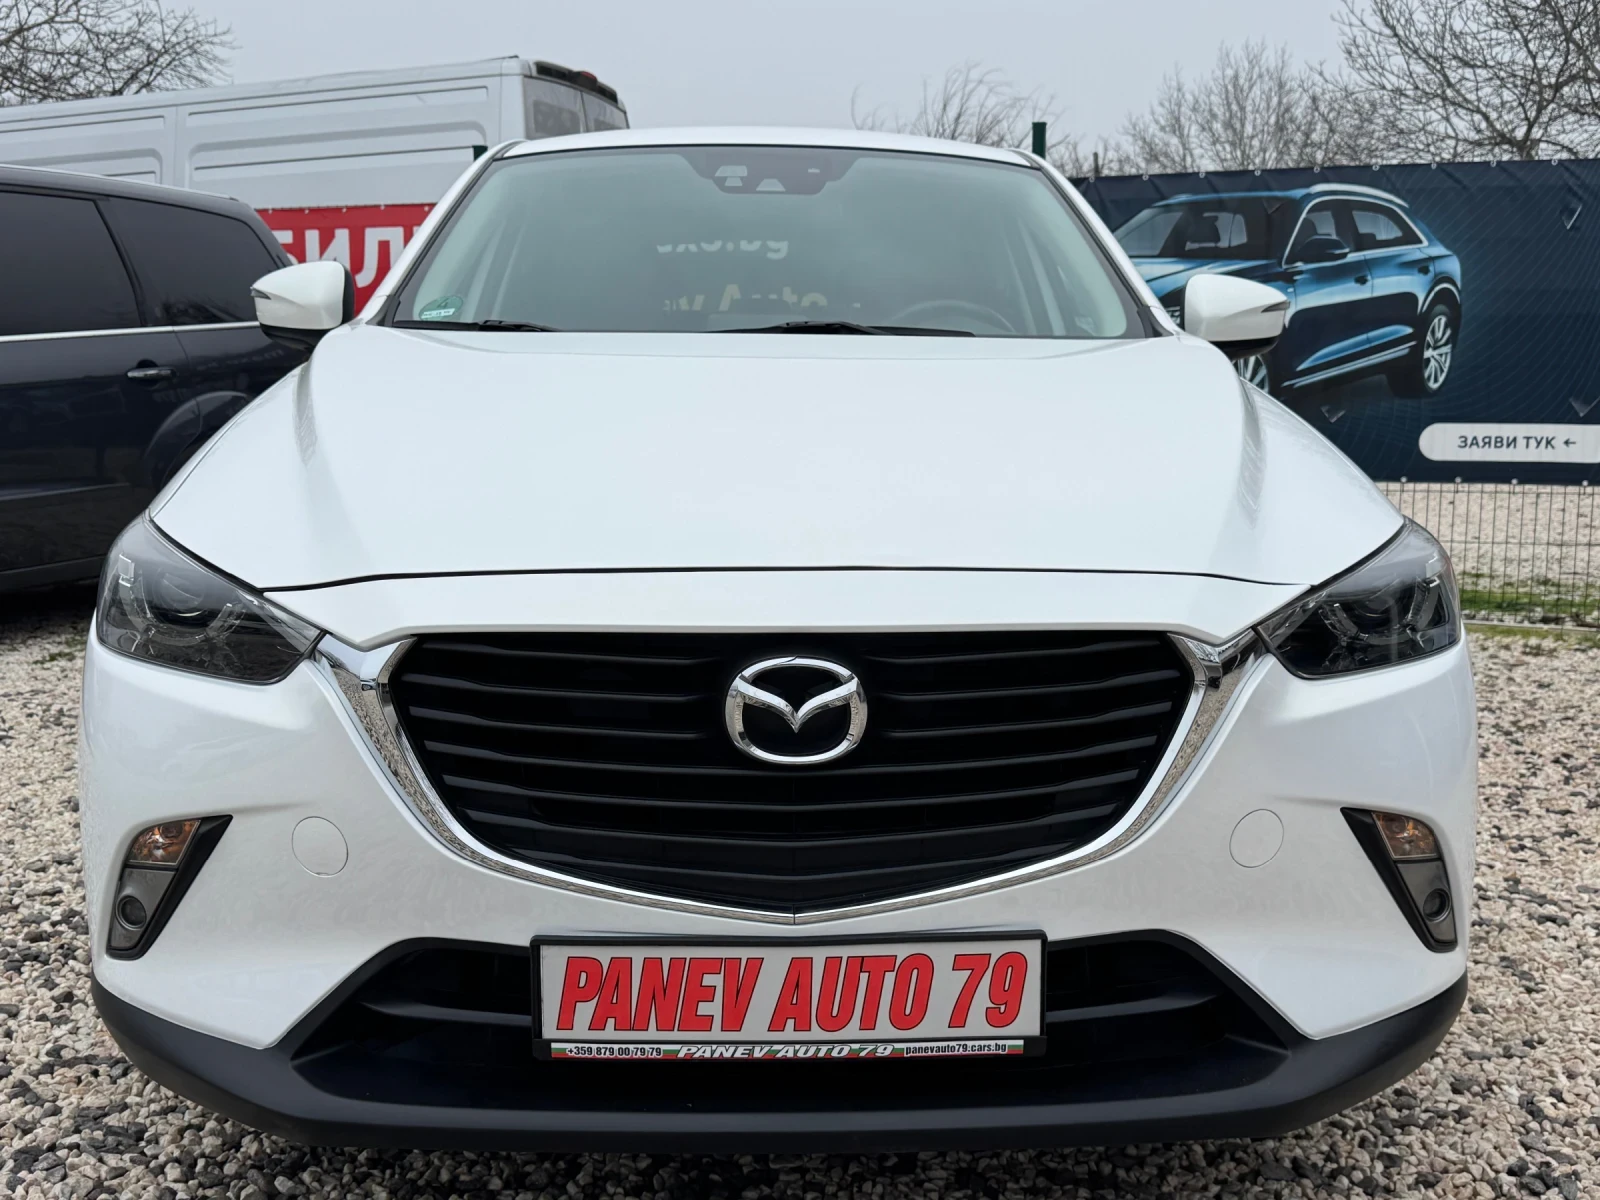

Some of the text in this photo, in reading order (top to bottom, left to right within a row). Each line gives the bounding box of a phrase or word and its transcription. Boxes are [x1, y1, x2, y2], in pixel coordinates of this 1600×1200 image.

[1457, 435, 1557, 450] ЗАЯВИ ТУК
[556, 951, 1029, 1033] PANEV AUTO 79
[567, 1046, 662, 1057] +359 879 00 79 79
[676, 1044, 895, 1059] PANEV AUTO 79
[905, 1042, 1007, 1056] panevauto79.cars.bg
